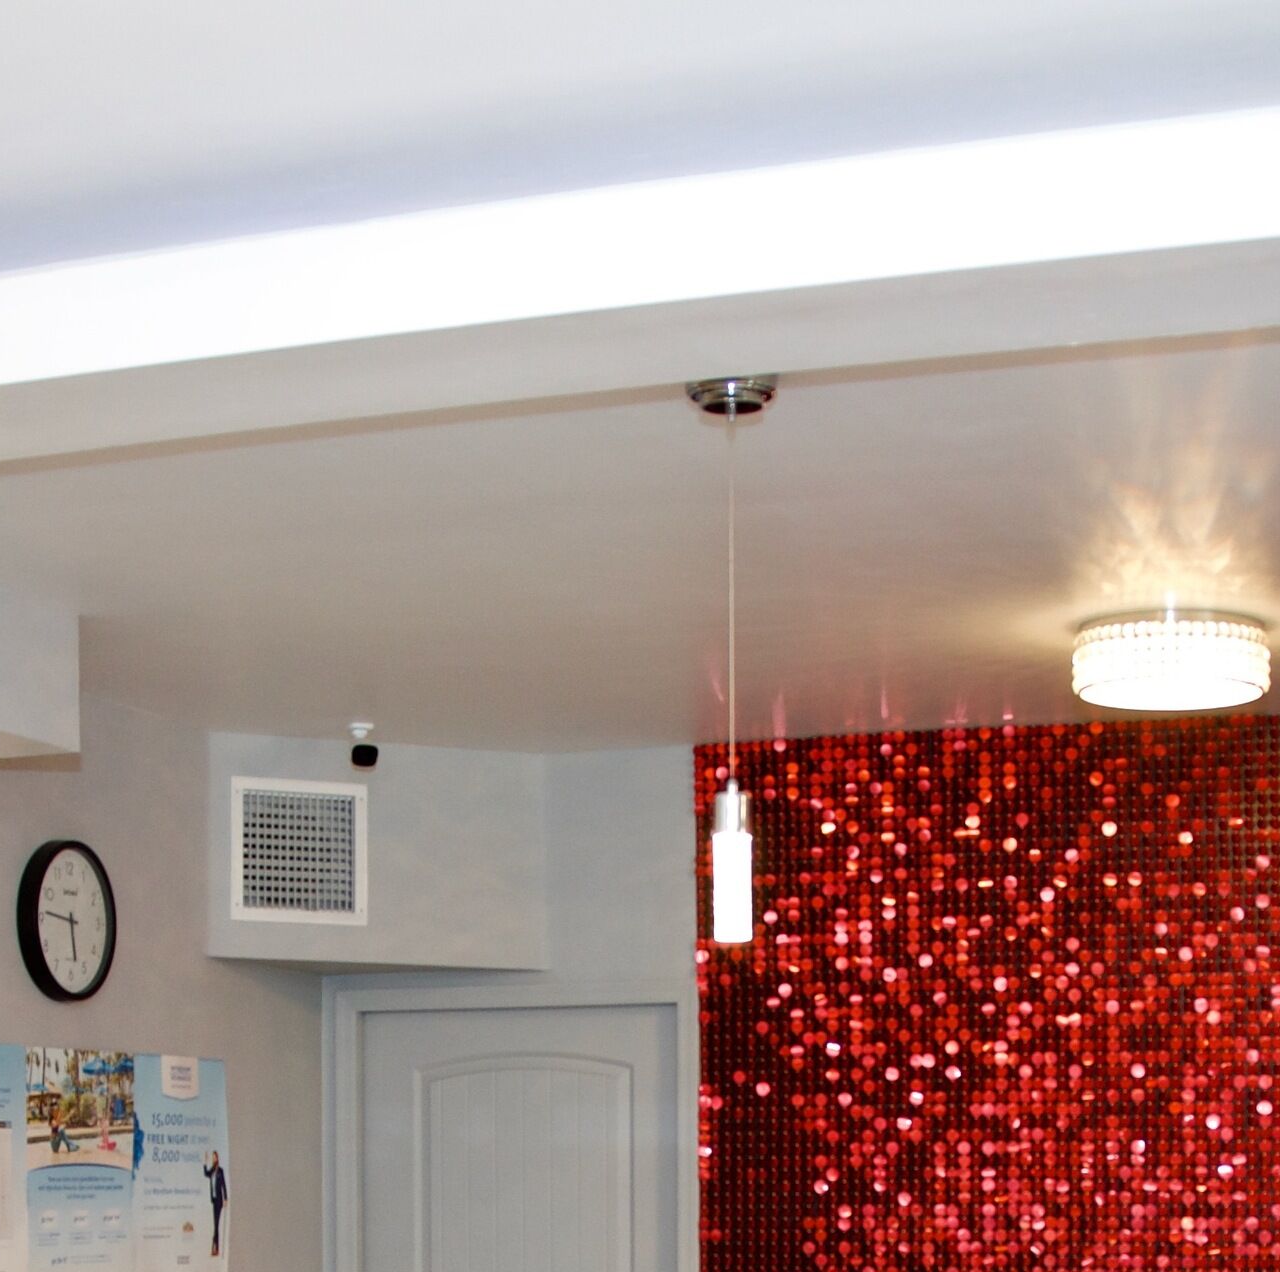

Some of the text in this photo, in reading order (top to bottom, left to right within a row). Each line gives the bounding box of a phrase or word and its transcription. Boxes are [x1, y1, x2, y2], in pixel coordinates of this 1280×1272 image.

[54, 866, 61, 880] 11
[65, 861, 74, 876] 12
[43, 886, 55, 901] 10
[152, 1112, 183, 1128] 15,000
[147, 1134, 165, 1145] FREE
[167, 1134, 189, 1145] NIGHT
[152, 1147, 180, 1163] 8,000
